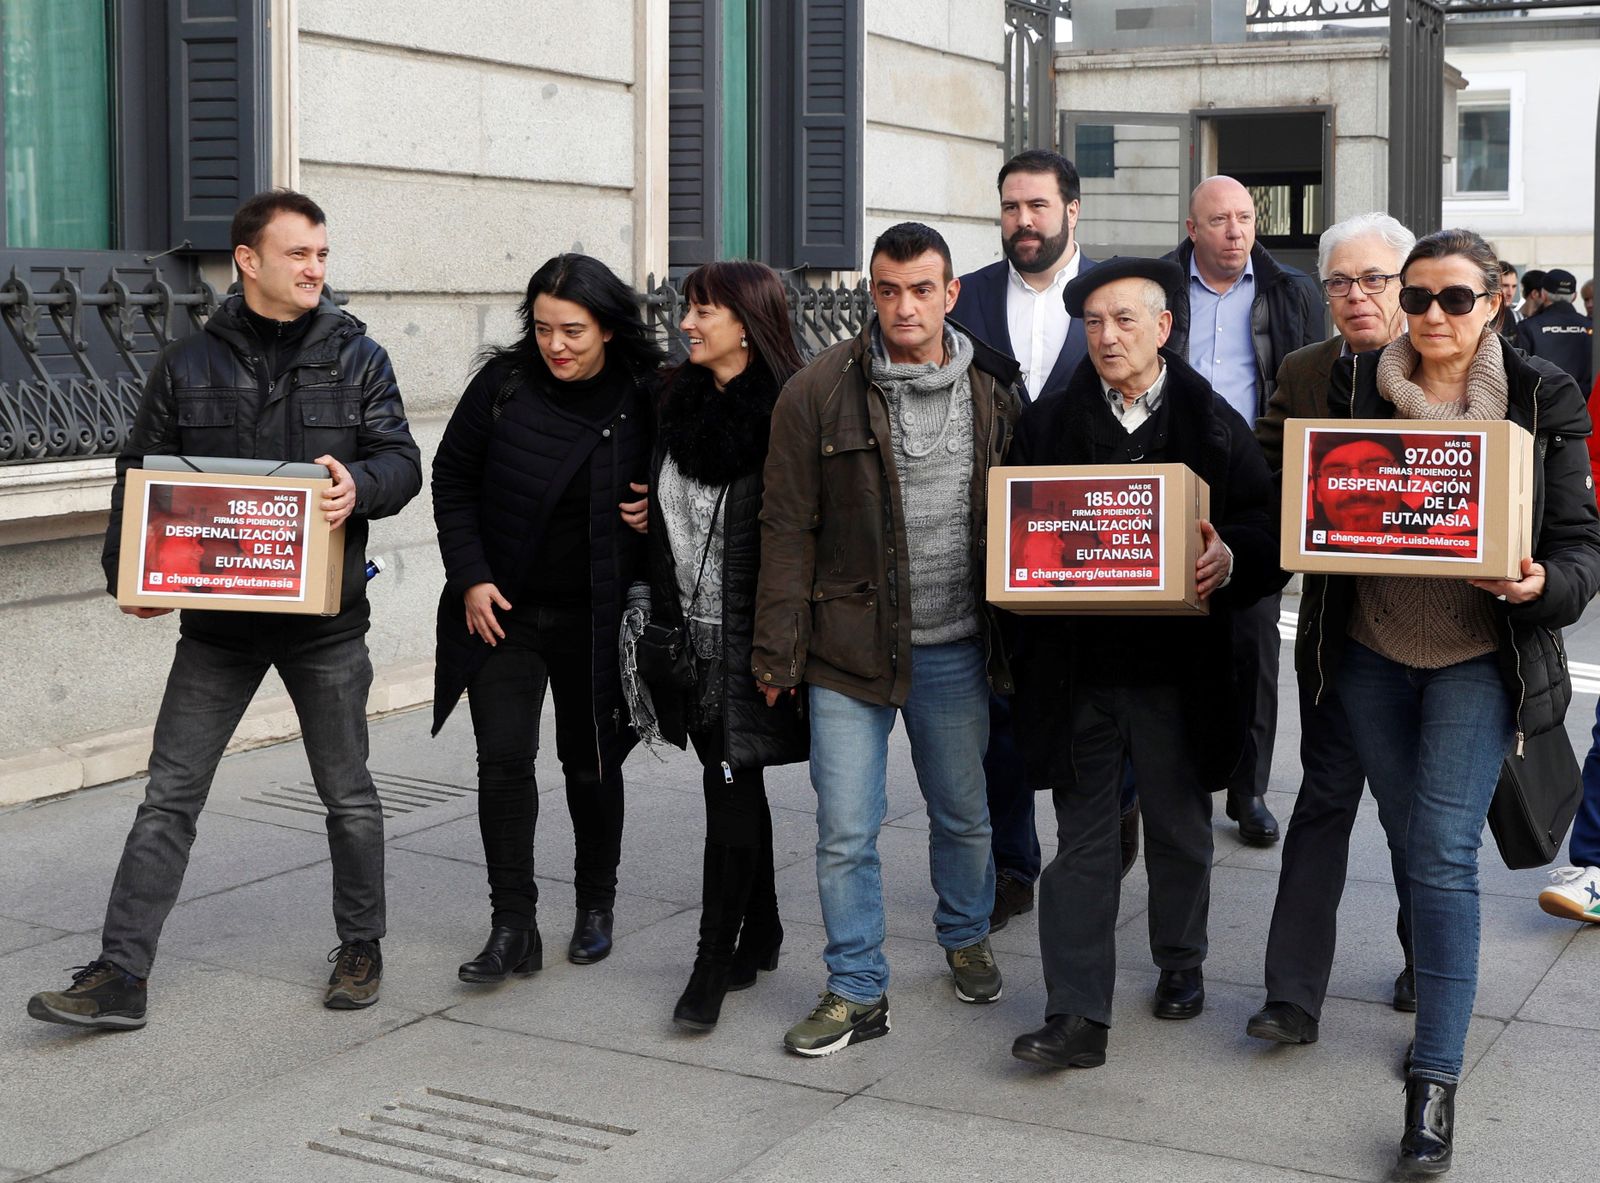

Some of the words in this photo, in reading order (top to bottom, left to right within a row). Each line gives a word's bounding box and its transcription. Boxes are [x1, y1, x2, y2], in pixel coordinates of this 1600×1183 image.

[1444, 440, 1460, 448] MÁS
[1404, 448, 1472, 466] 97.000
[1379, 467, 1412, 476] FIRMAS
[1414, 468, 1458, 477] PIDIENDO
[1459, 469, 1472, 477] LA
[1328, 477, 1470, 494] DESPENALIZACIÓN
[1084, 491, 1153, 507] 185.000
[1424, 496, 1444, 509] DE
[1448, 498, 1468, 510] LA
[227, 500, 298, 518] 185.000
[214, 516, 244, 525] FIRMAS
[246, 518, 284, 526] PIDIENDO
[286, 519, 298, 527] LA
[1028, 517, 1152, 532] DESPENALIZACIÓN
[1382, 512, 1471, 527] EUTANASIA
[166, 526, 296, 542] DESPENALIZACIÓN
[1112, 534, 1130, 544] DE
[1133, 533, 1151, 544] LA
[1330, 533, 1470, 547] change.org/PorLuisDeMarcos
[254, 543, 273, 554] DE
[276, 544, 294, 556] LA
[1076, 548, 1153, 560] EUTANASIA
[215, 556, 296, 570] EUTANASIA
[166, 572, 294, 588] change.org/eutanasia
[1032, 568, 1153, 582] change.org/eutanasia
